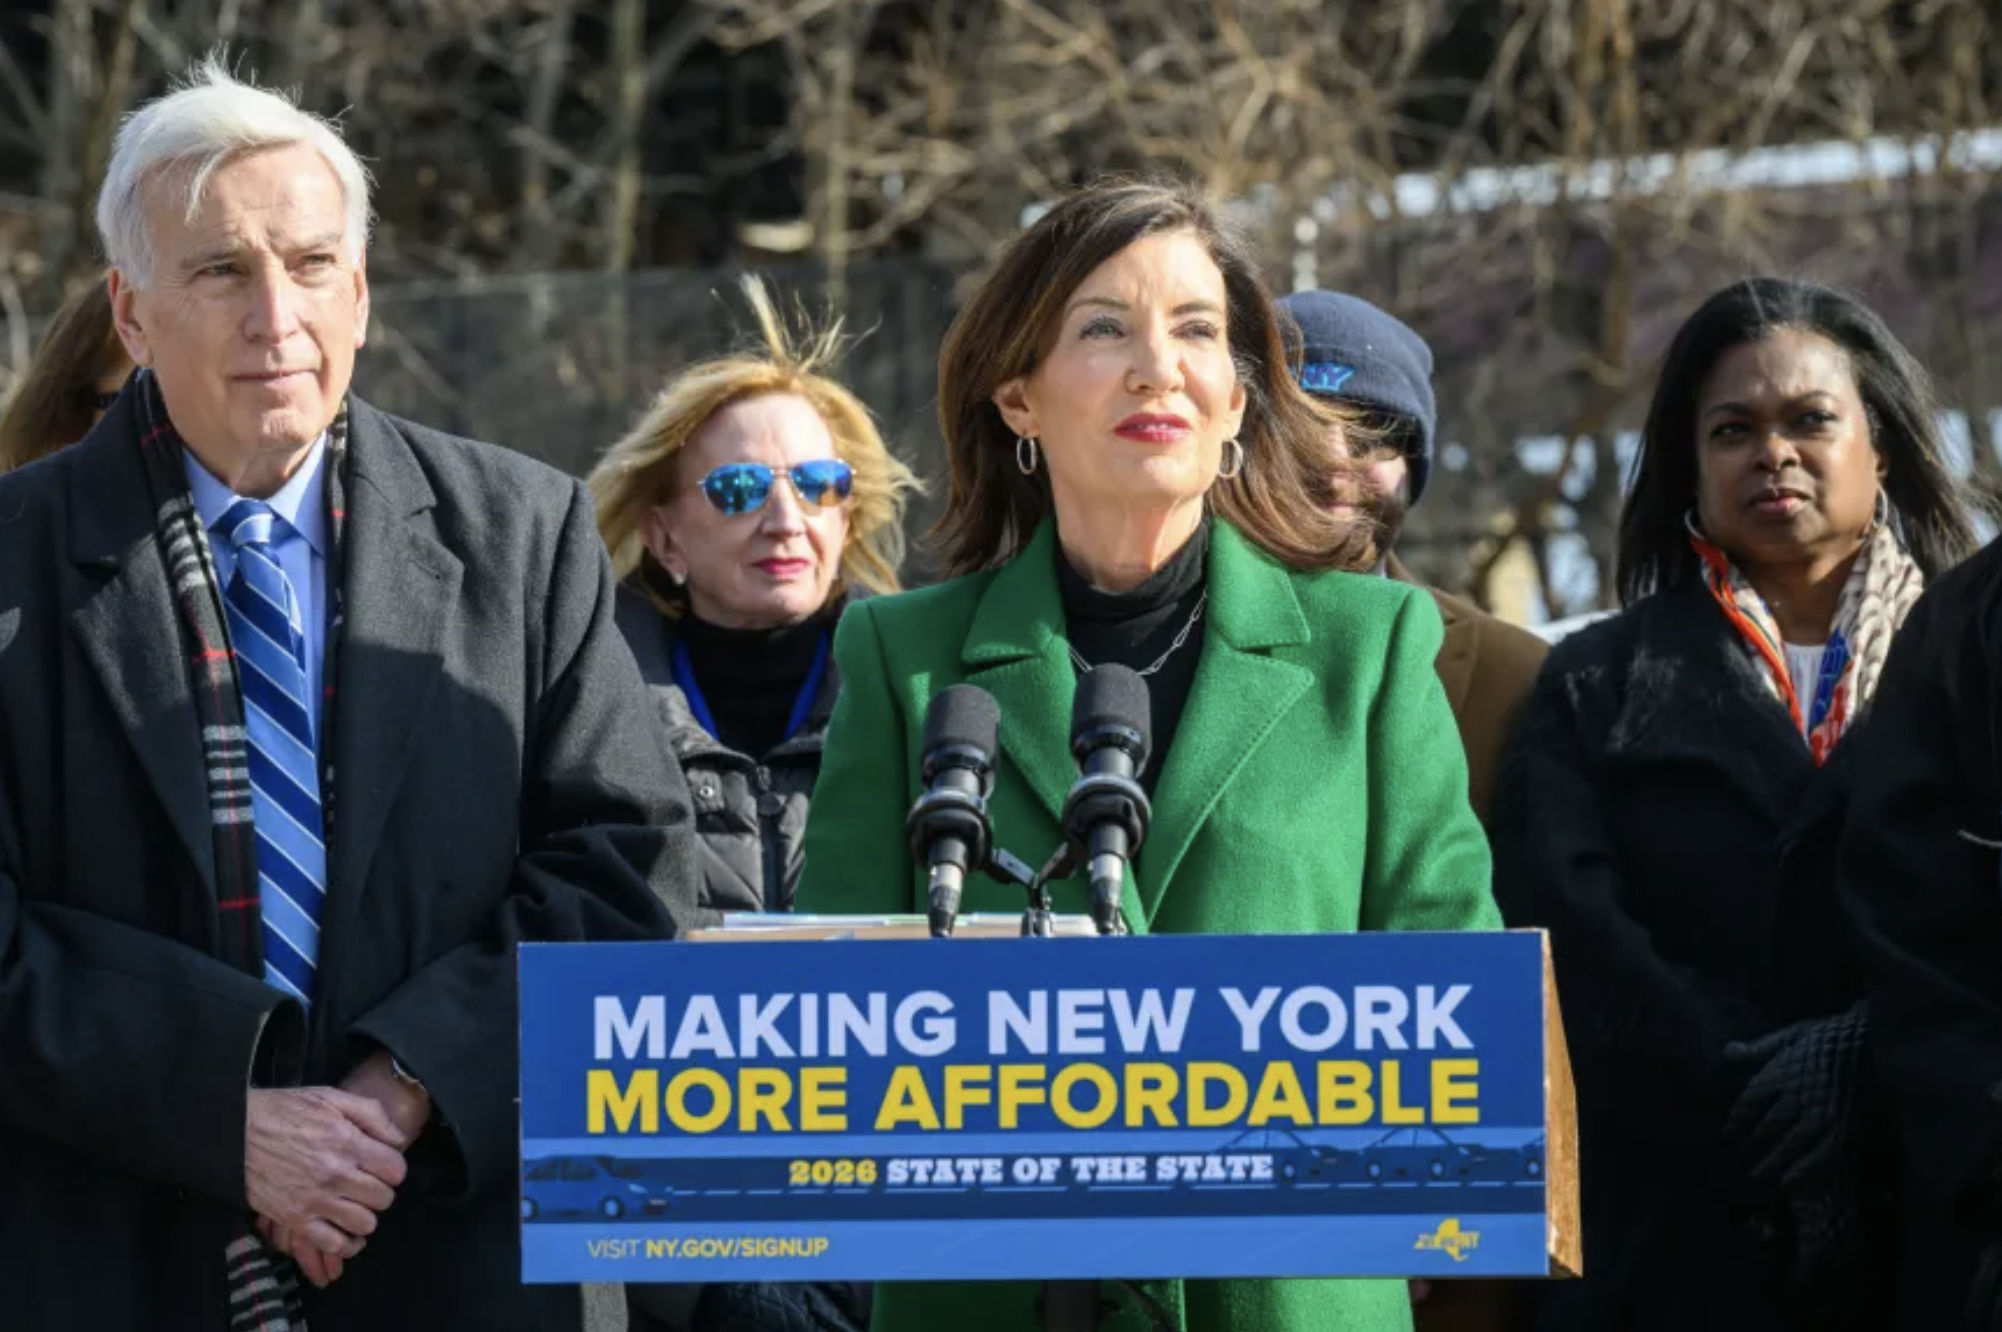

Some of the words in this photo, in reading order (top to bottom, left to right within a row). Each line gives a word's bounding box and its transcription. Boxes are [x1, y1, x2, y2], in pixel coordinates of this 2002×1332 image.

[594, 990, 956, 1060] MAKING
[988, 988, 1195, 1055] NEW
[1220, 985, 1474, 1052] YORK
[586, 1067, 848, 1134] MORE
[875, 1058, 1480, 1130] AFFORDABLE
[789, 1160, 877, 1186] 2026
[887, 1158, 1003, 1184] STATE
[1013, 1158, 1061, 1183] OF
[1071, 1156, 1147, 1182] THE
[1156, 1155, 1273, 1181] STATE
[587, 1239, 641, 1259] VISIT
[645, 1236, 829, 1258] NY.GOV/SIGNUP
